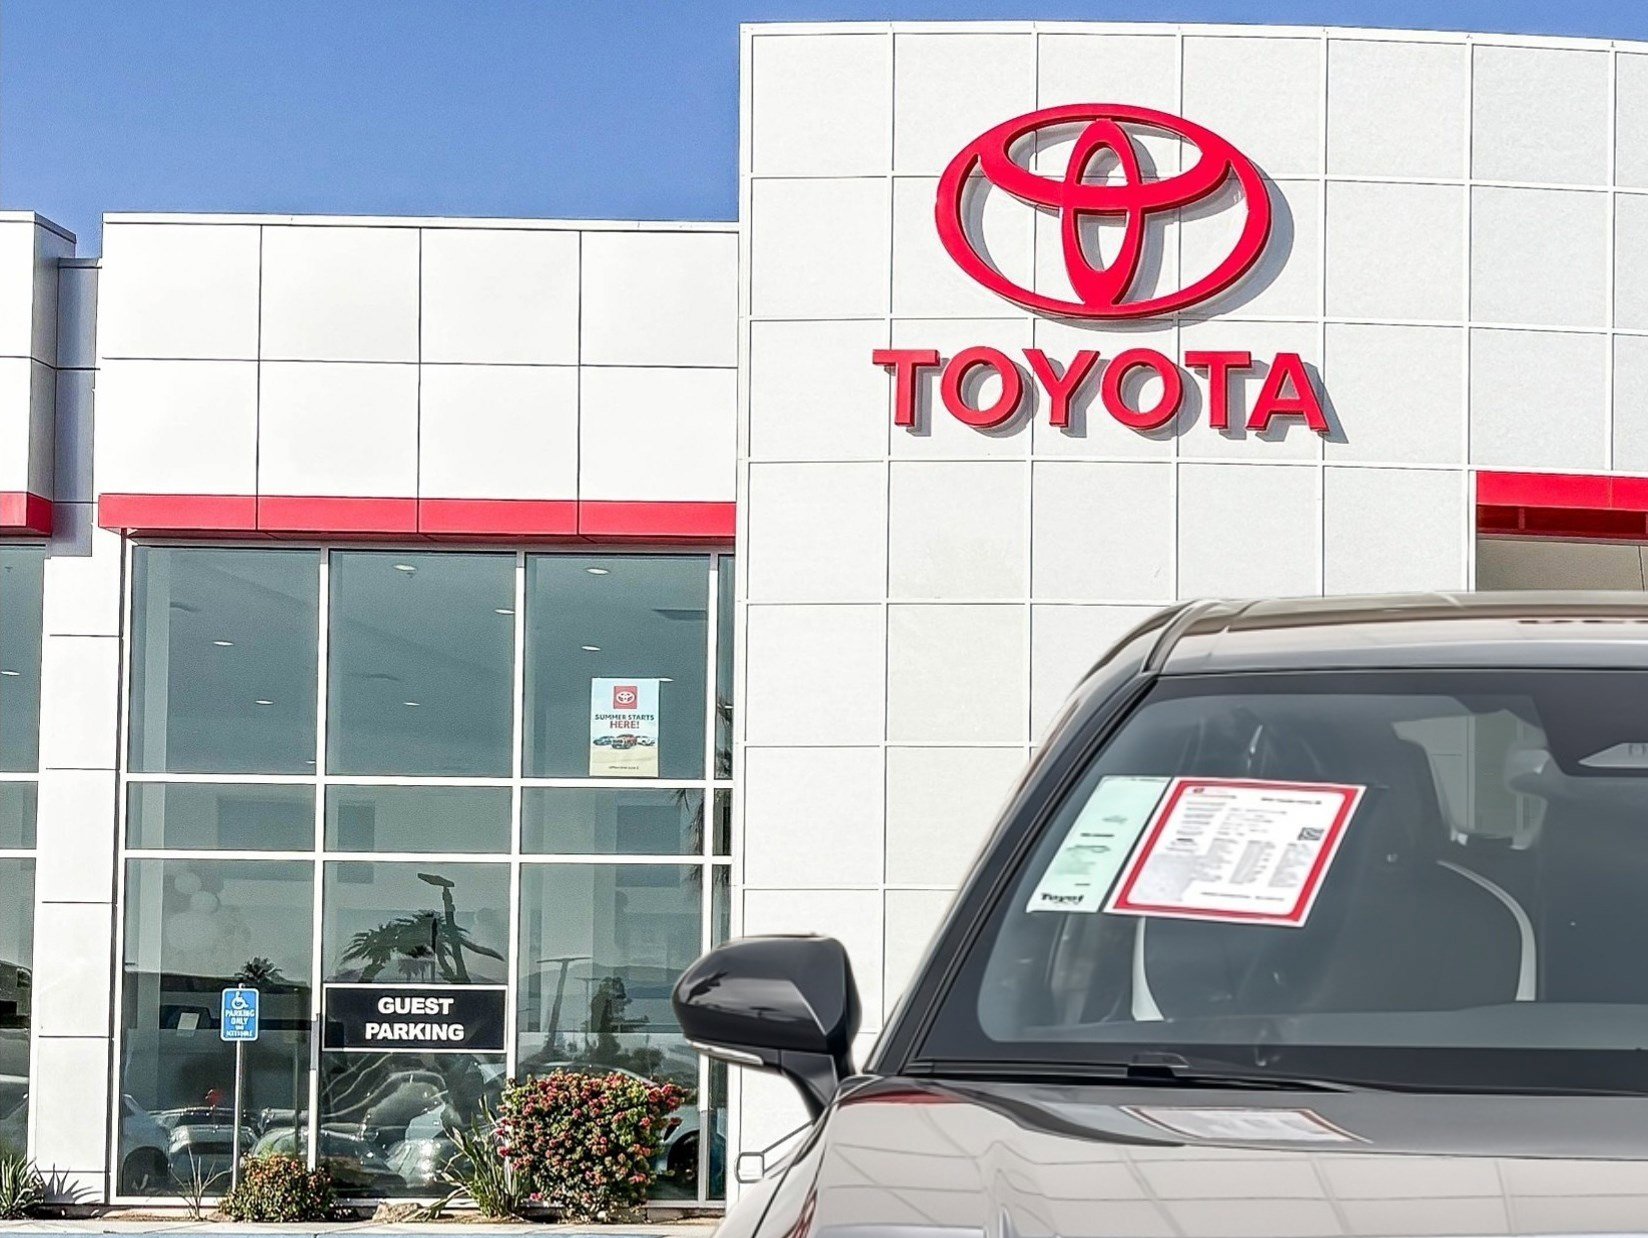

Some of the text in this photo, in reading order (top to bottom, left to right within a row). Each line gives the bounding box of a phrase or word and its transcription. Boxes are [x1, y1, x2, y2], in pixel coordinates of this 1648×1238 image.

[872, 346, 1330, 433] TOYOTA
[610, 720, 640, 729] HERE!
[377, 997, 454, 1016] GUEST
[365, 1022, 465, 1041] PARKING
